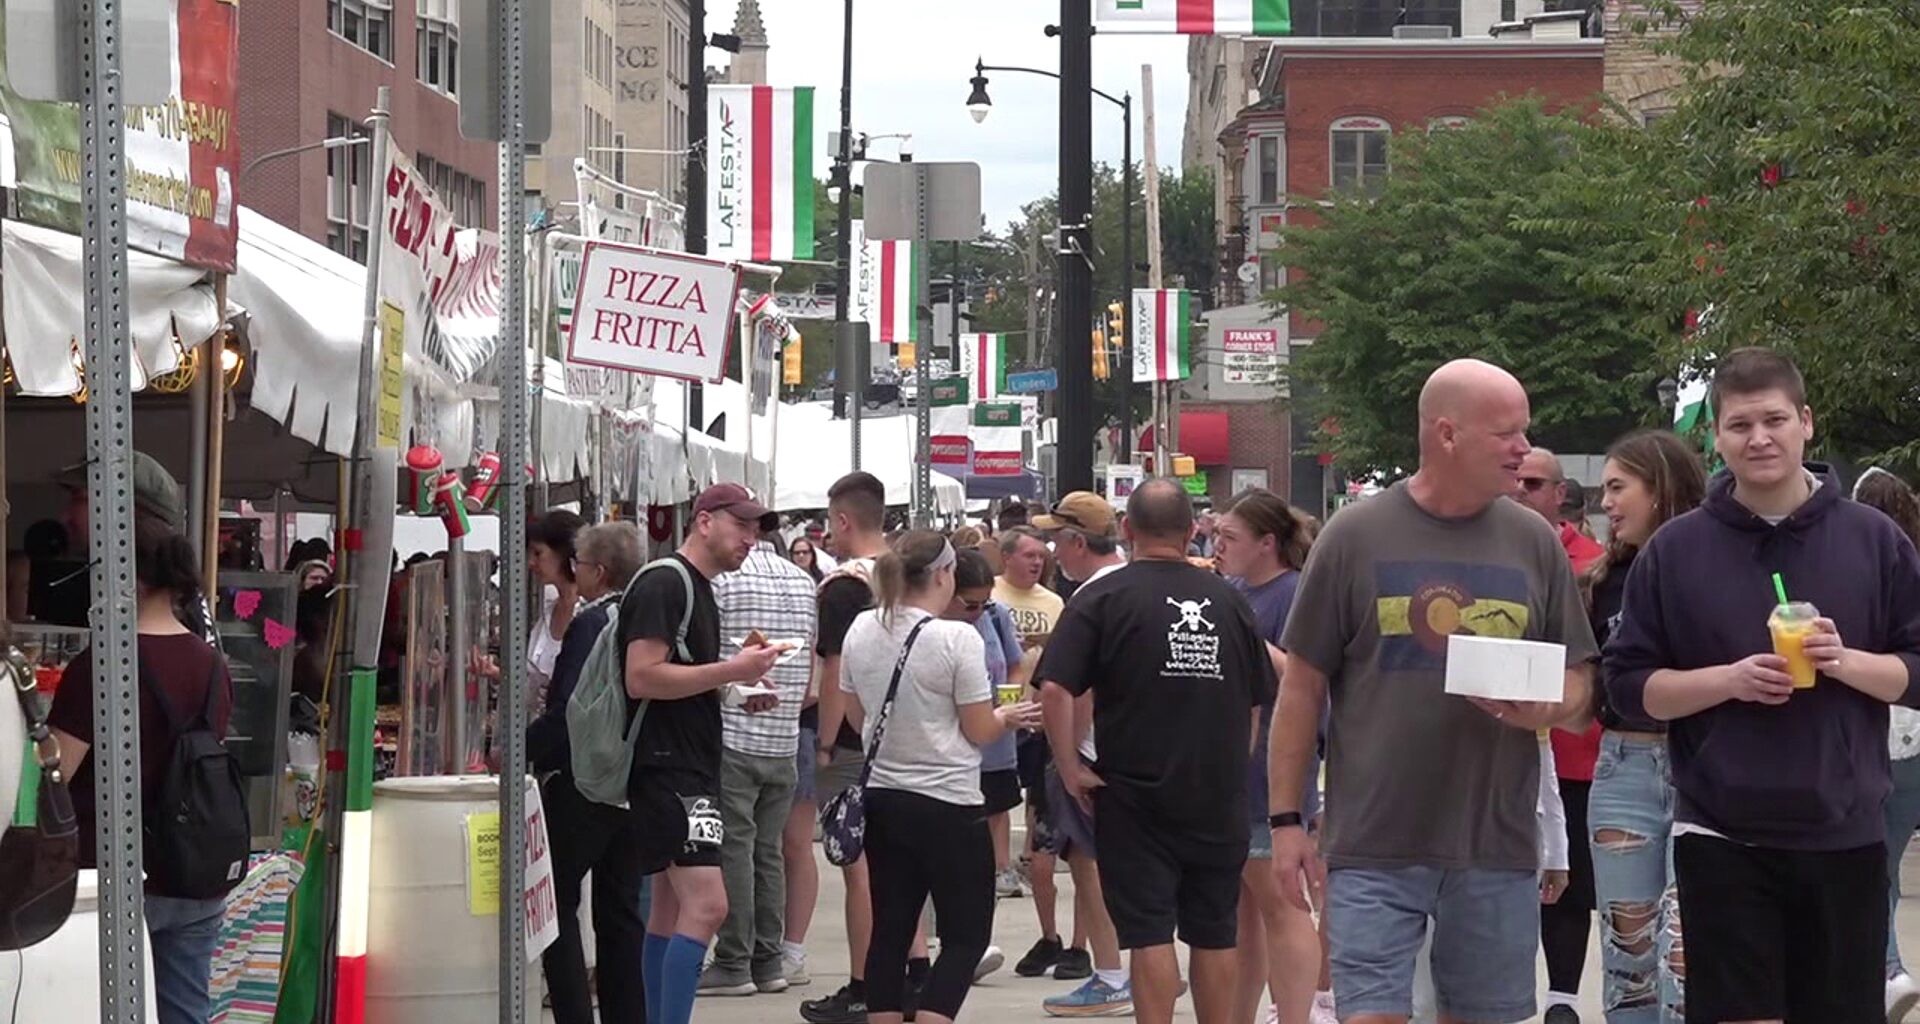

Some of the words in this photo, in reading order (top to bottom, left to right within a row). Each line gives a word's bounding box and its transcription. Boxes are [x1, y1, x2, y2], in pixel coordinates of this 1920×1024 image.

[603, 266, 708, 314] PIZZA
[857, 245, 869, 321] AFESTA
[590, 308, 707, 358] FRITTA
[1229, 331, 1272, 341] FRANK'S
[1167, 631, 1219, 646] Pillaging
